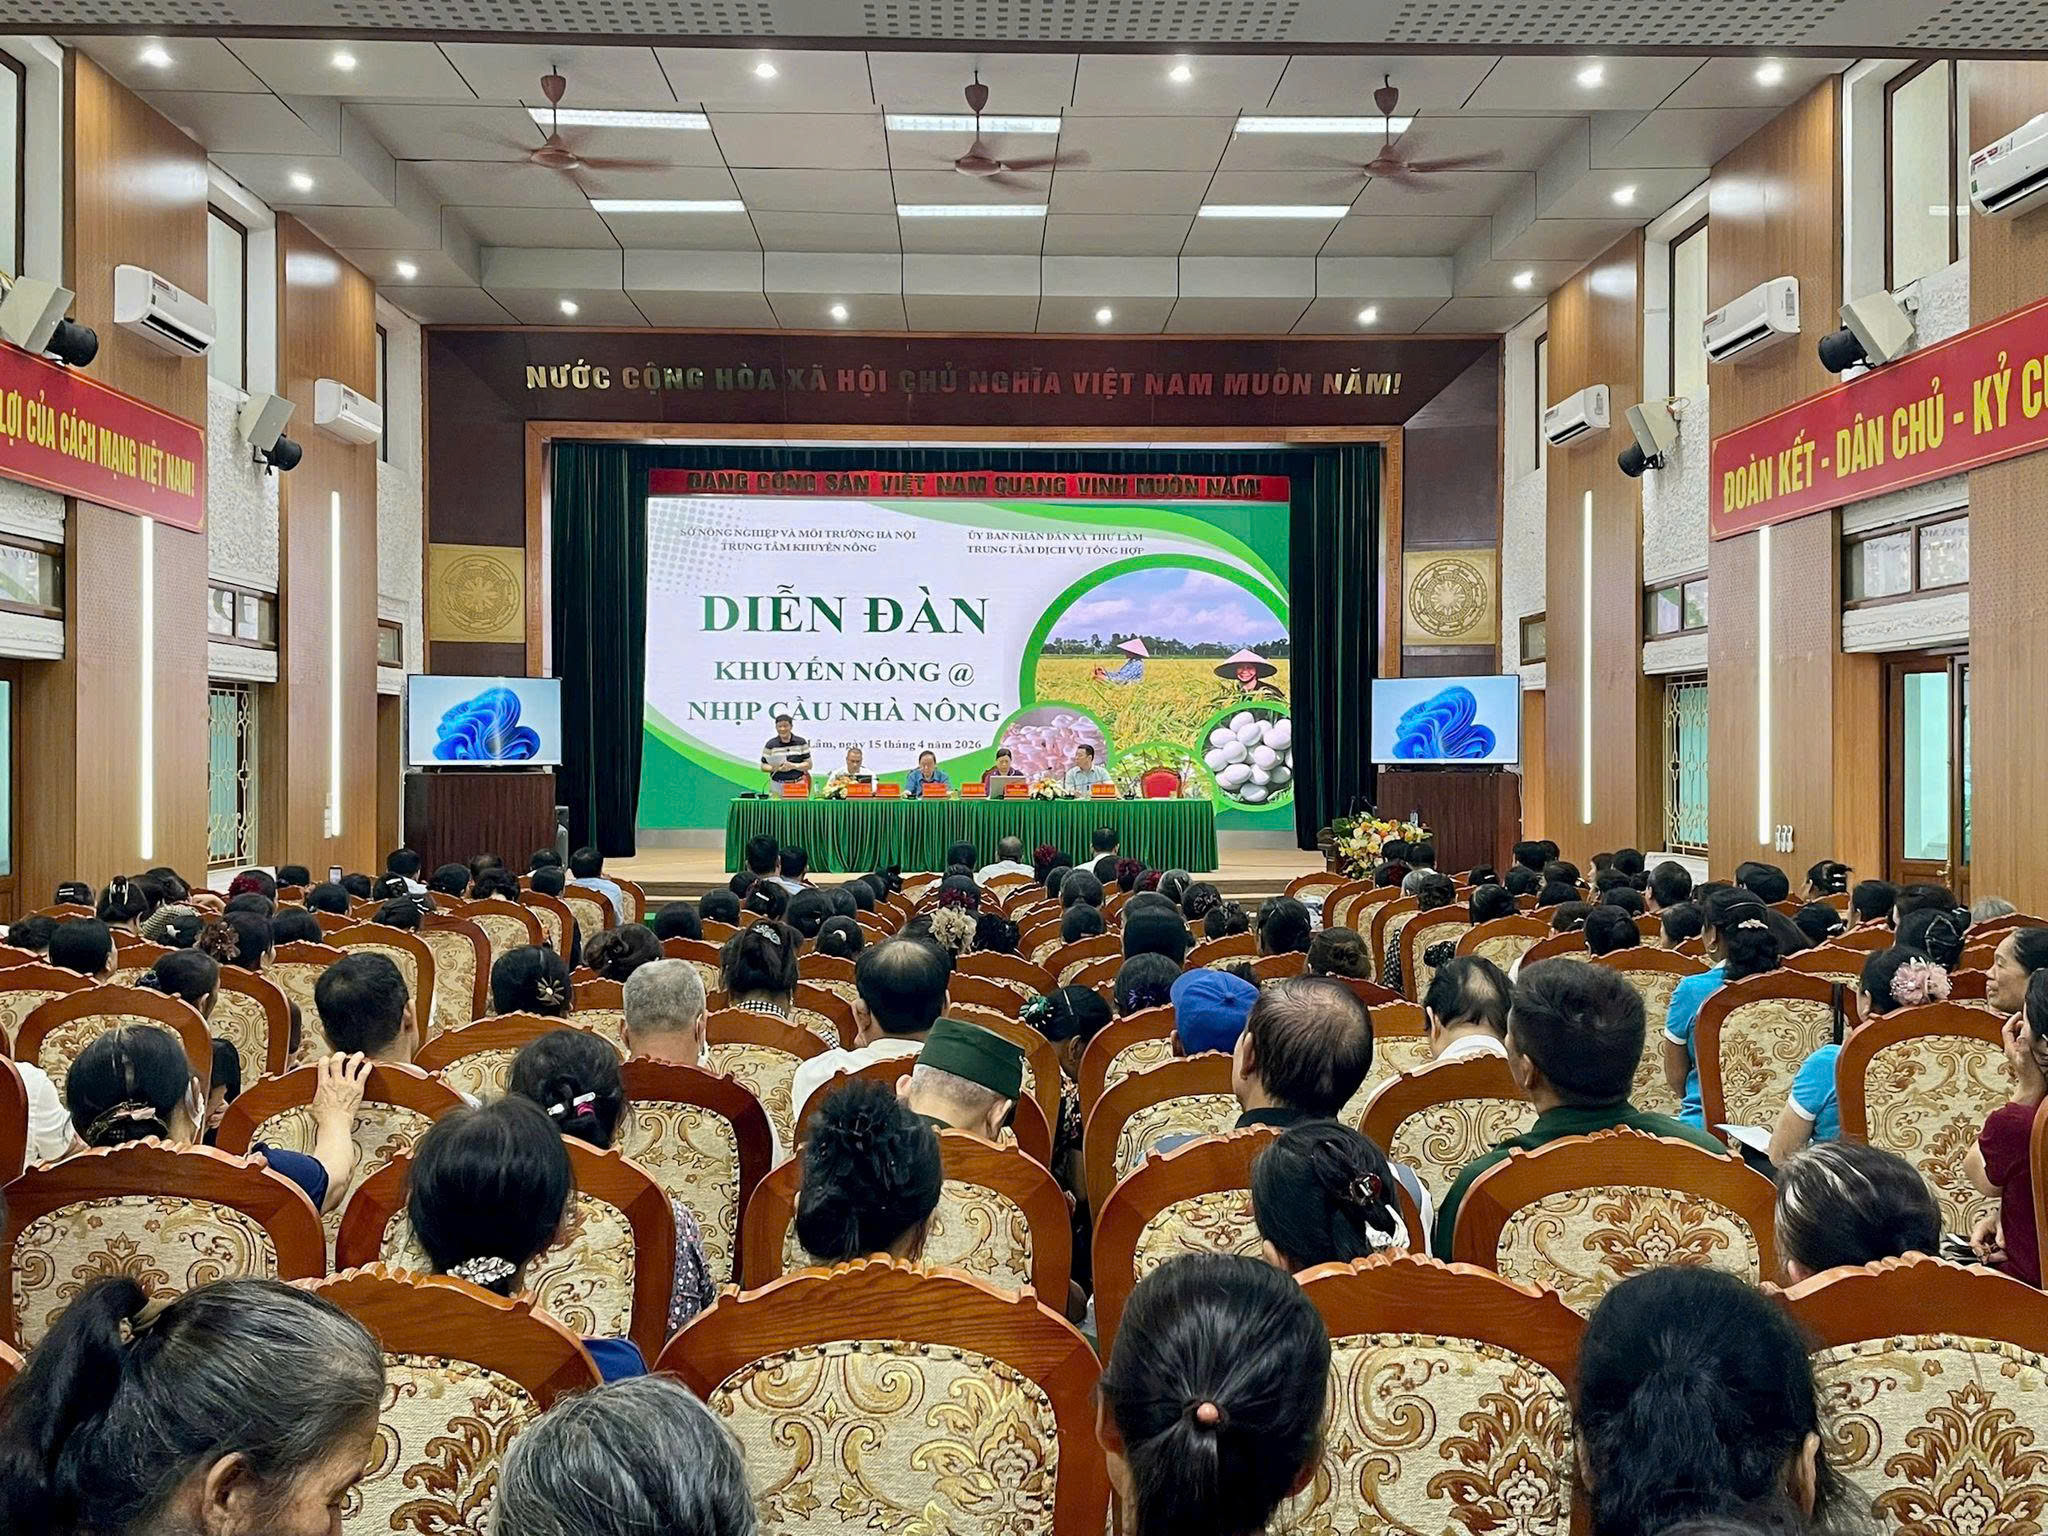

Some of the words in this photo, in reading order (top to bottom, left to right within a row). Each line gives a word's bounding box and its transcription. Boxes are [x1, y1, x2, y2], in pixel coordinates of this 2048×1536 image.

[526, 358, 610, 389] NƯỚC
[622, 361, 704, 395] CỘNG
[715, 362, 776, 391] HÒA
[787, 364, 828, 392] XÃ
[837, 364, 888, 397] HỘI
[901, 361, 957, 393] CHỦ
[969, 366, 1060, 395] NGHĨA
[1074, 367, 1134, 399] VIỆT
[1144, 373, 1212, 395] NAM
[1223, 367, 1312, 395] MUÔN
[1322, 367, 1401, 395] NĂM!
[0, 388, 22, 446] LỢI
[27, 389, 56, 450] CỦA
[60, 408, 96, 464] CÁCH
[99, 427, 136, 480] MẠNG
[140, 440, 164, 493] VIỆT
[166, 453, 195, 497] NAM!
[1723, 453, 1773, 513] ĐOÀN
[1778, 429, 1816, 496] KẾT
[1836, 409, 1885, 478] DÂN
[1892, 376, 1944, 460] CHỦ
[1973, 351, 2012, 435] KỶ
[936, 475, 987, 492] NAM
[994, 476, 1067, 496] QUANG
[1078, 477, 1128, 495] VINH
[699, 528, 732, 538] NÔNG
[735, 529, 779, 540] NGHIỆP
[781, 528, 796, 538] VÀ
[800, 528, 823, 539] MÔI
[825, 528, 875, 540] TRƯỜNG
[895, 530, 916, 541] NỘI
[986, 532, 1009, 541] BAN
[1011, 531, 1044, 541] NHÂN
[721, 542, 763, 552] TRUNG
[765, 541, 792, 552] TÂM
[843, 542, 877, 553] NÔNG
[968, 545, 1007, 554] TRUNG
[1009, 545, 1036, 554] TÂM
[1037, 546, 1066, 556] DỊCH
[1068, 546, 1085, 557] VỤ
[699, 584, 847, 633] DIỄN
[863, 586, 990, 634] ĐÀN
[853, 657, 940, 683] NÔNG
[949, 662, 975, 687] @
[688, 701, 762, 725] NHỊP
[840, 697, 905, 722] NHÀ
[913, 697, 1000, 723] NÔNG
[869, 739, 882, 749] 15
[884, 738, 916, 751] tháng
[917, 740, 924, 749] 4
[927, 740, 952, 749] năm
[955, 740, 982, 749] 2026
